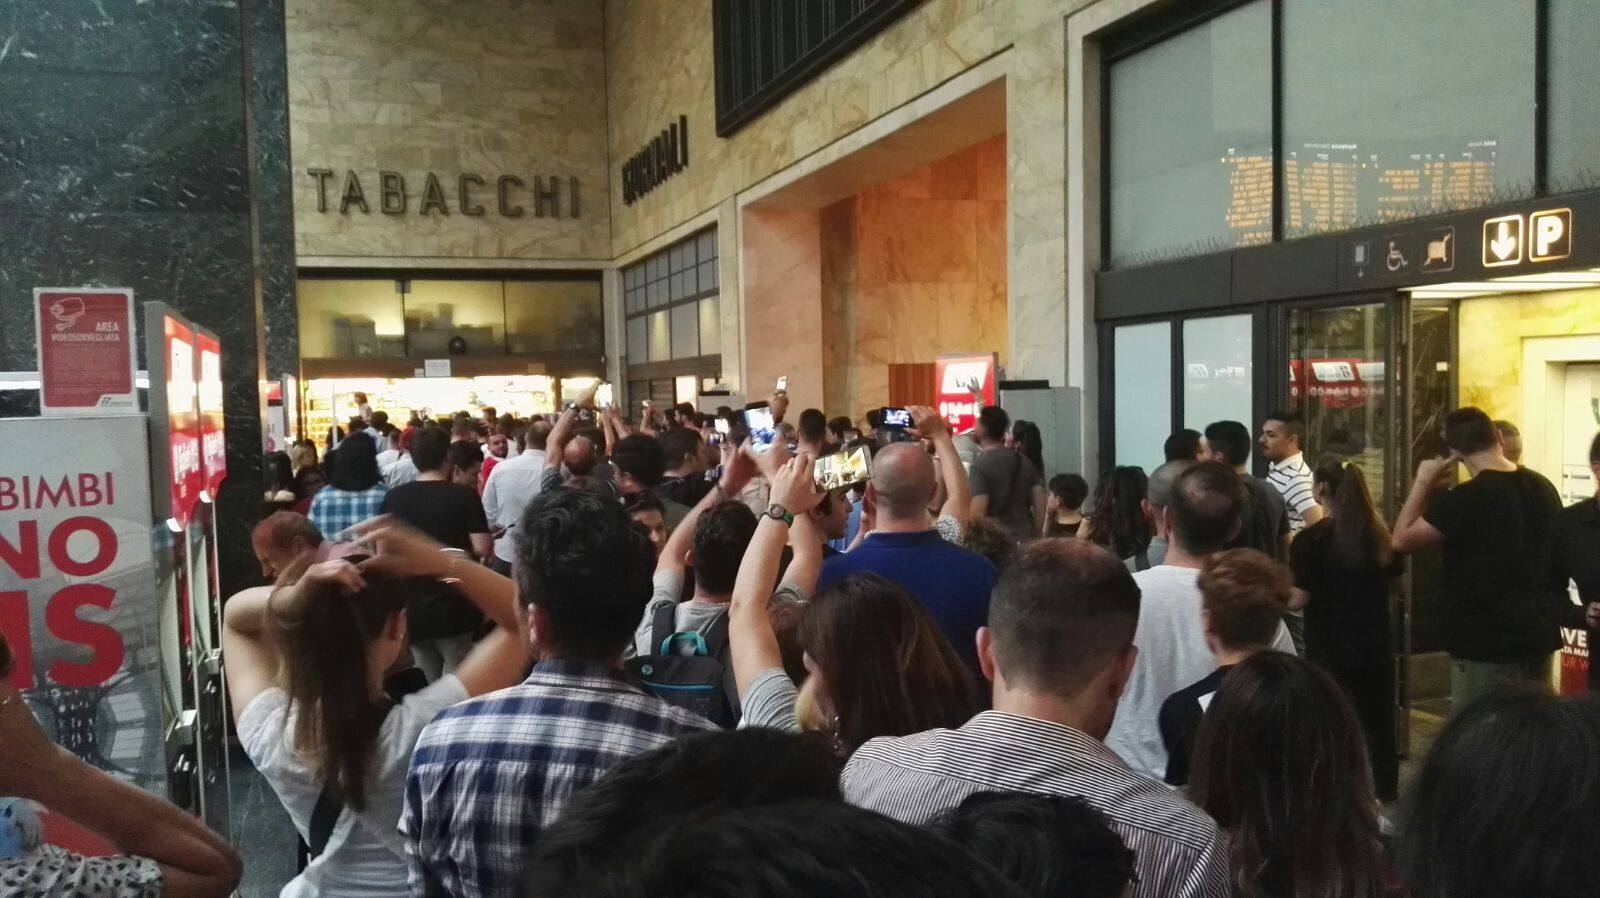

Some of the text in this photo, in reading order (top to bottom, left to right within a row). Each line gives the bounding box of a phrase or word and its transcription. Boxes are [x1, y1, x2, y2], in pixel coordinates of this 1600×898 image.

[307, 168, 580, 218] TABACCHI
[1537, 215, 1563, 256] P
[96, 321, 119, 332] AREA
[0, 472, 114, 511] BIMBI
